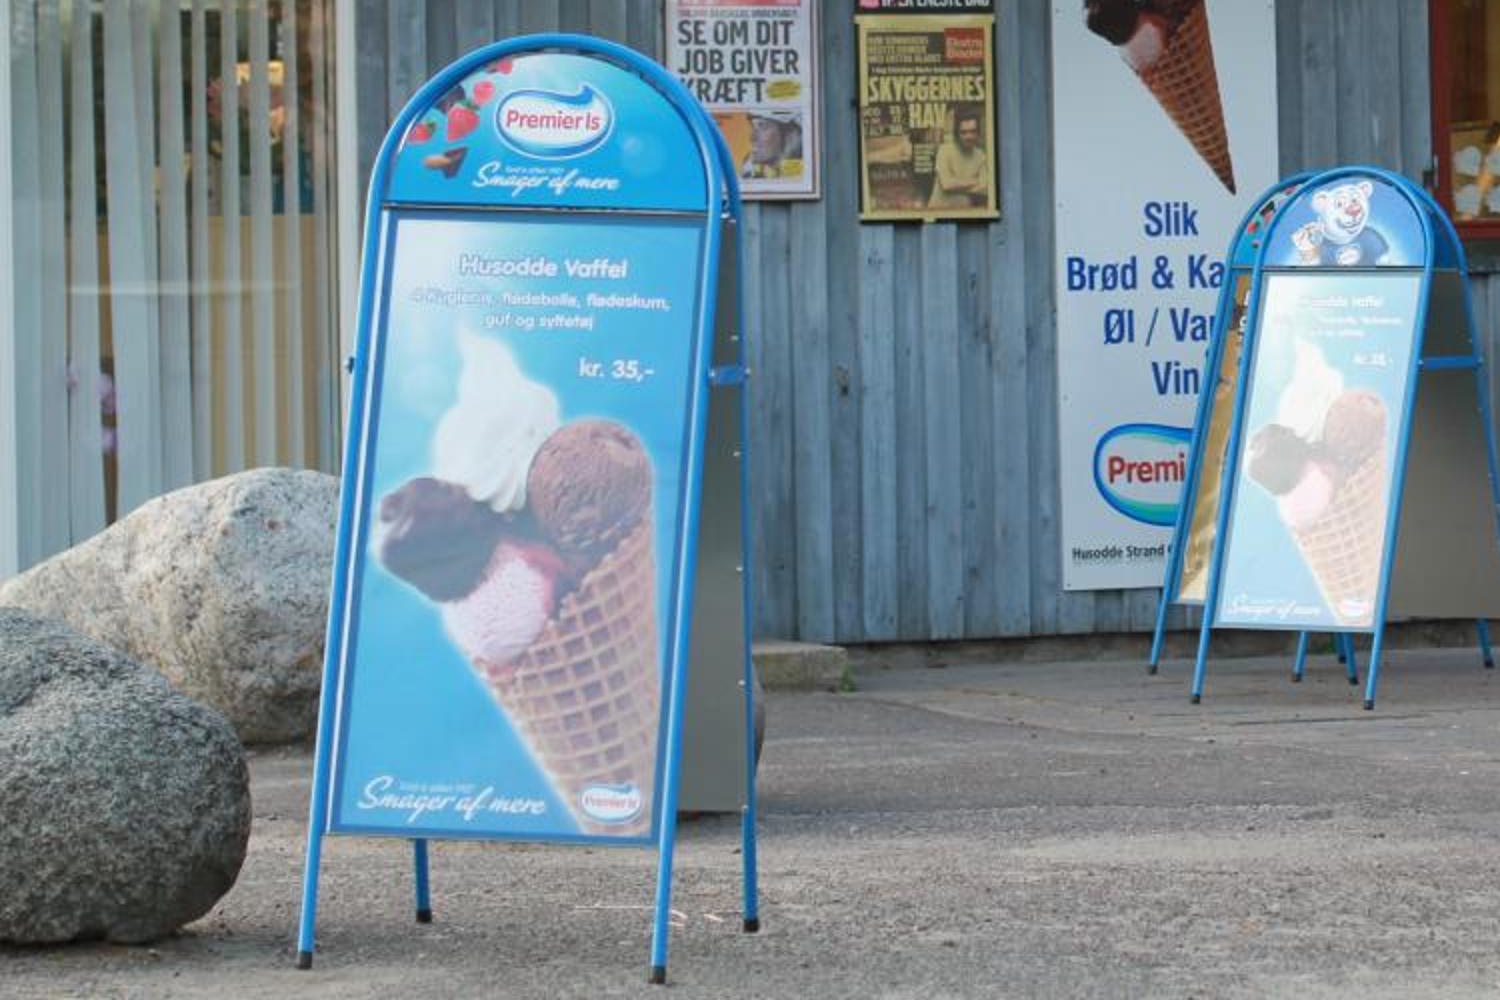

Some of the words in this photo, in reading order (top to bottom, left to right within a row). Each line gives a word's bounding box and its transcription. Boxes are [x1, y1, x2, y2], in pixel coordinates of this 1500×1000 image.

[677, 20, 707, 46] SE
[713, 20, 749, 46] OM
[755, 20, 794, 45] DIT
[678, 48, 725, 75] JOB
[730, 48, 800, 75] GIVER
[868, 75, 985, 102] SKYGGERNES
[909, 103, 947, 129] HAV
[472, 161, 546, 198] Smager
[576, 176, 621, 191] mere
[1143, 201, 1199, 237] Slik
[459, 254, 558, 278] Husodde
[564, 258, 628, 279] Vaffel
[1066, 255, 1138, 291] Brød
[1151, 255, 1175, 290] &
[485, 312, 511, 330] guf
[515, 316, 536, 331] og
[1103, 308, 1135, 345] Øl
[1144, 307, 1159, 347] /
[578, 357, 605, 377] kr.
[611, 359, 655, 382] 35,-
[1151, 361, 1200, 395] Vin
[1072, 546, 1124, 561] Husodde
[1126, 544, 1165, 558] Strand
[357, 775, 455, 824] Smager
[491, 797, 546, 815] mere
